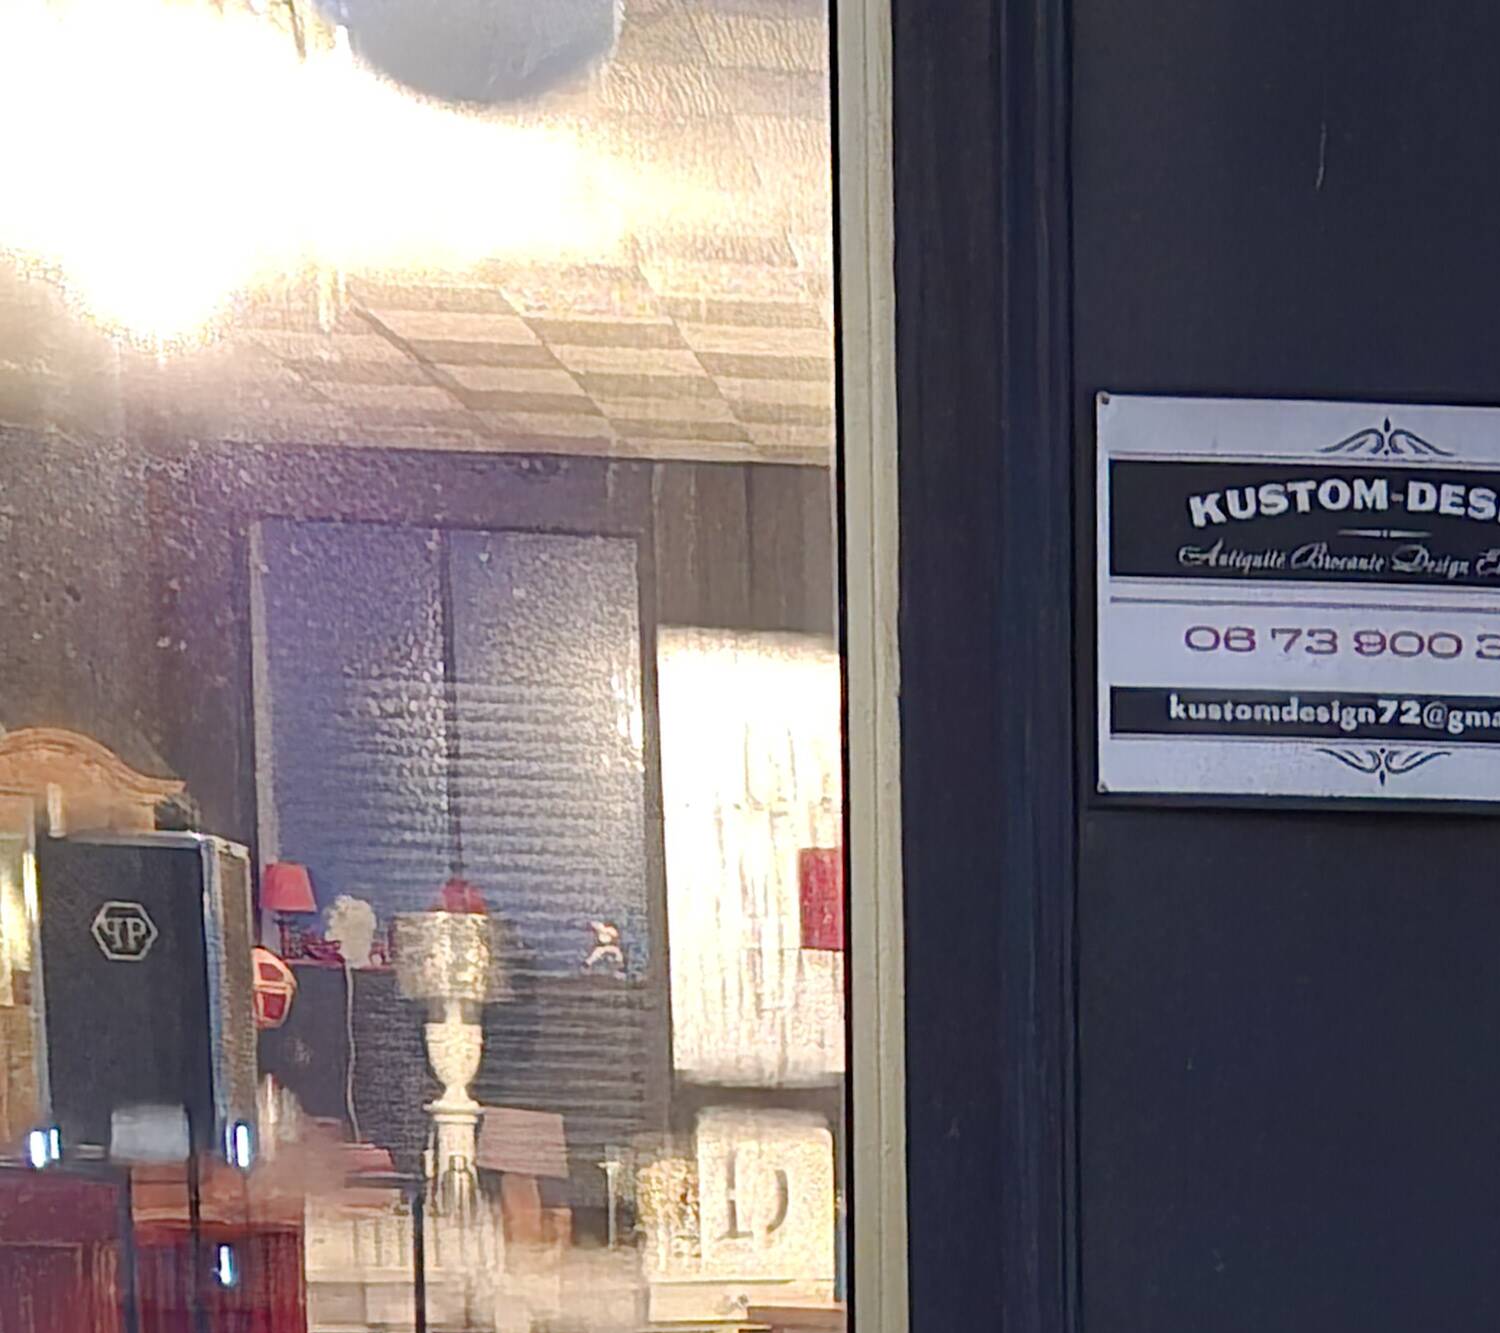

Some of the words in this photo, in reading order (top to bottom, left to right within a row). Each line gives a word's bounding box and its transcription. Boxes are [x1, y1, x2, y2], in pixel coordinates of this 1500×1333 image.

[1291, 542, 1385, 573] Brocante
[1391, 544, 1469, 580] Design
[1270, 627, 1339, 655] 73
[1353, 630, 1463, 660] 900
